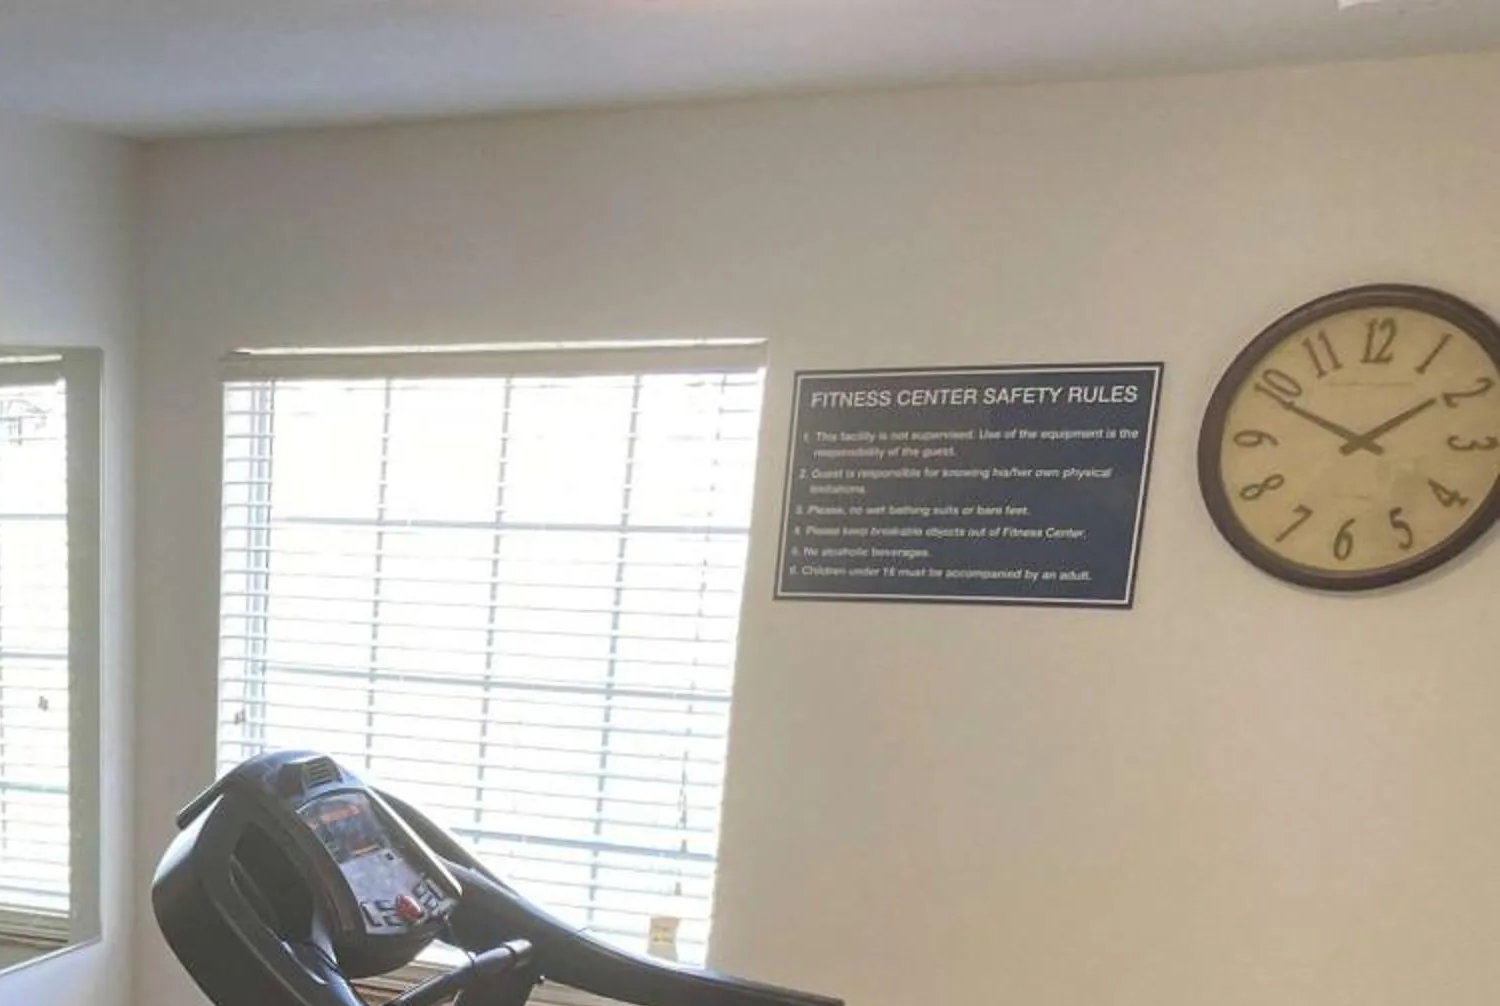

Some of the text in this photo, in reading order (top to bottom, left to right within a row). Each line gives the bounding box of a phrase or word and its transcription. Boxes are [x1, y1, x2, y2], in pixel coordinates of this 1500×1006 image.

[1302, 329, 1344, 379] 11
[1360, 317, 1397, 364] 12
[1414, 332, 1454, 375] 1
[810, 384, 1139, 409] FITNESS CENTER SAFETY RULES
[1253, 368, 1303, 411] 10
[1442, 376, 1496, 408] 2
[840, 431, 875, 443] facility
[890, 430, 909, 441] not
[979, 429, 1001, 440] Use
[1004, 428, 1018, 440] of
[1019, 428, 1038, 439] the
[1041, 428, 1103, 441] equipment
[1105, 429, 1117, 439] is
[1119, 427, 1139, 439] the
[1233, 429, 1280, 448] 9
[1446, 434, 1500, 452] 3
[887, 447, 901, 458] of
[901, 446, 919, 458] the
[922, 447, 956, 460] guest.
[811, 468, 844, 479] Guest
[857, 468, 921, 481] responsible
[924, 467, 940, 479] for
[1035, 468, 1060, 478] own
[1062, 466, 1113, 481] physical
[1239, 473, 1285, 501] 8
[1427, 478, 1469, 508] 4
[850, 505, 864, 515] no
[866, 506, 886, 515] wet
[888, 505, 931, 517] bathing
[933, 505, 960, 515] suits
[962, 506, 975, 515] or
[976, 504, 1003, 516] bare
[1005, 504, 1031, 516] feet.
[1275, 504, 1314, 543] 7
[925, 527, 965, 540] objects
[967, 527, 987, 538] out
[988, 526, 1002, 538] of
[1002, 527, 1043, 538] Fitness
[1045, 527, 1088, 539] Center.
[1333, 517, 1357, 561] 6
[1388, 506, 1414, 550] 5
[802, 564, 847, 575] Children
[898, 567, 926, 577] must
[945, 567, 1023, 580] accompanied
[1024, 568, 1039, 582] by
[1041, 571, 1057, 580] an
[1058, 569, 1093, 582] adult.
